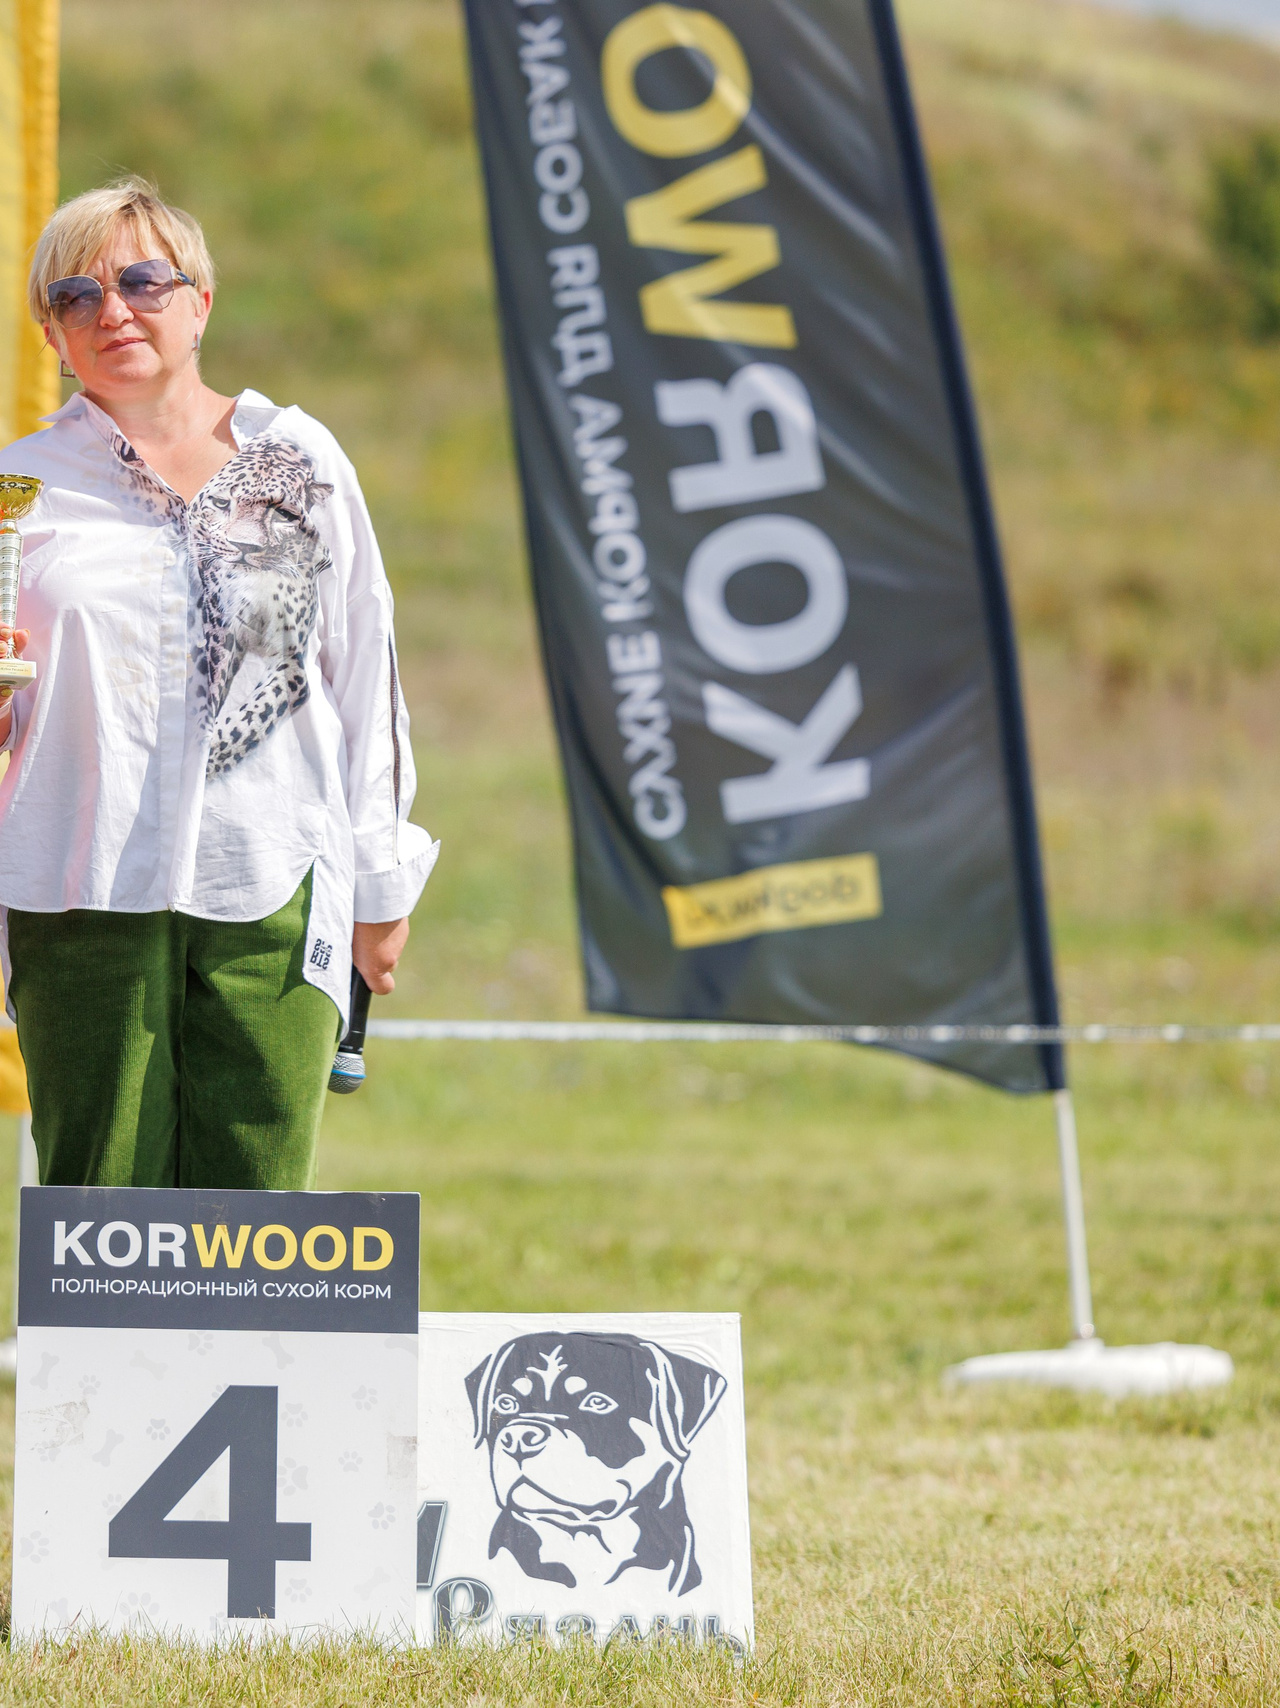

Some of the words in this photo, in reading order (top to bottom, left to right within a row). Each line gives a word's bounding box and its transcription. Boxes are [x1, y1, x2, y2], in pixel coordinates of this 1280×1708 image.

[53, 1220, 395, 1272] KORWOOD
[51, 1278, 257, 1299] ПОЛНОРАЦИОННЫЙ
[262, 1280, 329, 1299] СУХОЙ
[334, 1283, 392, 1300] КОРМ
[108, 1384, 312, 1619] 4
